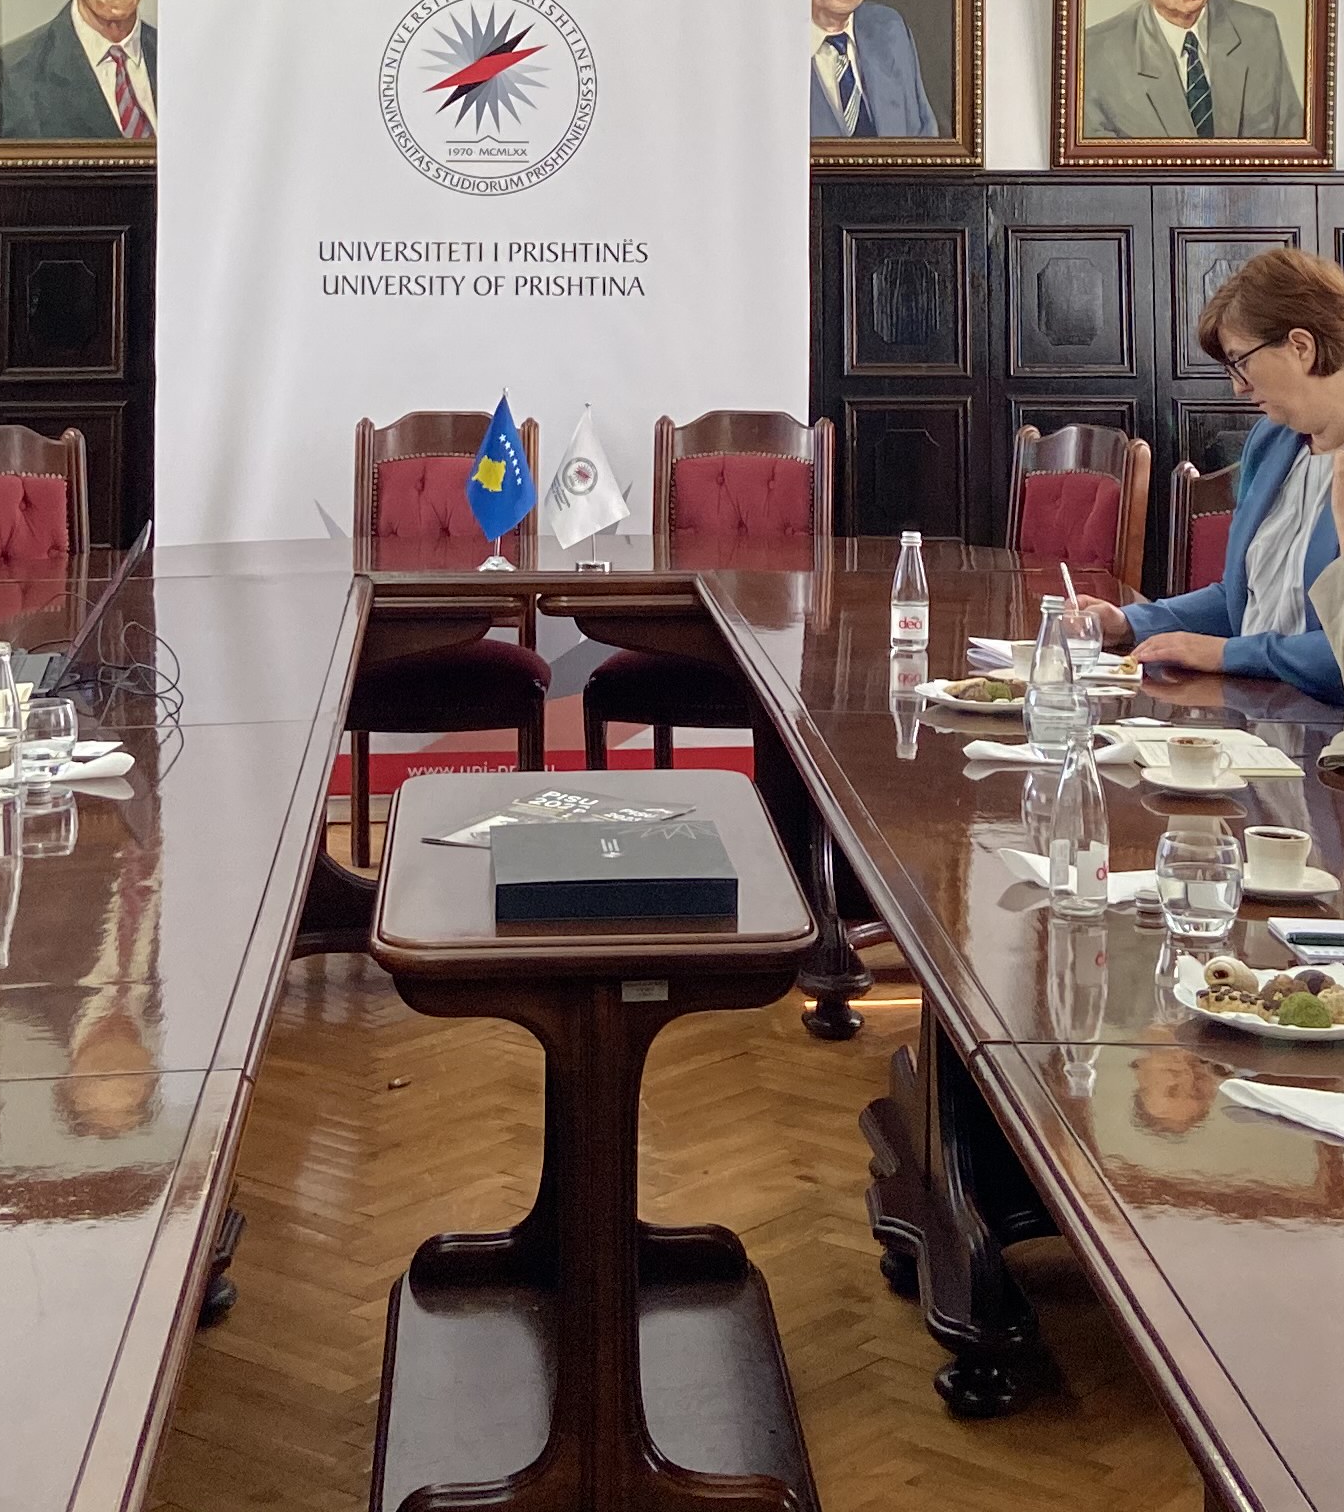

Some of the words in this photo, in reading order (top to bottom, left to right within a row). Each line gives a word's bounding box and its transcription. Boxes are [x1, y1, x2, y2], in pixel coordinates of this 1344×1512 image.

[382, 87, 433, 172] UNIVERSITAS
[431, 166, 526, 194] STUDIORUM
[526, 88, 595, 184] PRISHTINIENSIS
[448, 147, 474, 157] 1970
[479, 147, 528, 157] MCMLXX
[318, 240, 484, 263] UNIVERSITETI
[493, 241, 499, 262] I
[508, 238, 649, 264] PRISHTINËS
[321, 274, 467, 297] UNIVERSITY
[472, 274, 506, 297] OF
[514, 274, 646, 297] PRISHTINA
[541, 790, 600, 806] PISU
